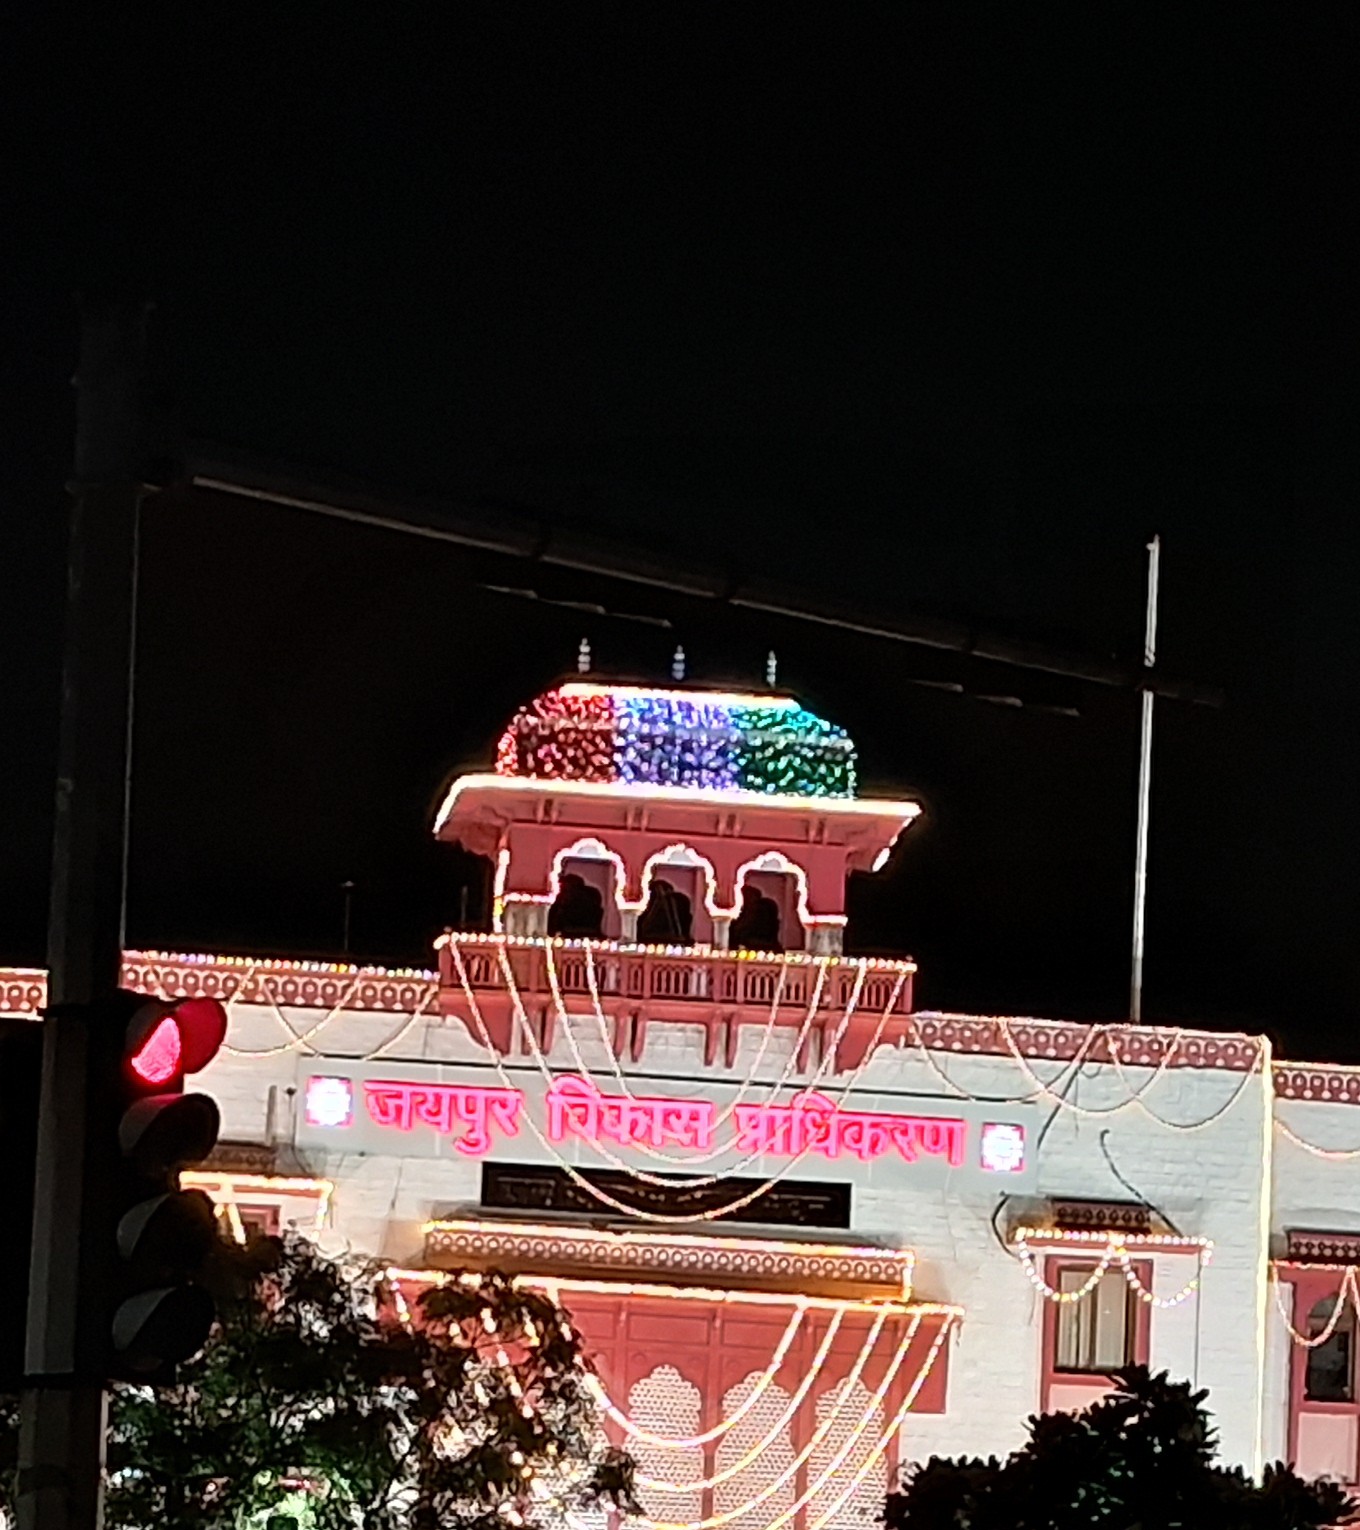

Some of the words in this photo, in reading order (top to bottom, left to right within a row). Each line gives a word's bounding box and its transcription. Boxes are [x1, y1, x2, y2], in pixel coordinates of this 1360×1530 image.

[363, 1080, 523, 1155] जयपुर
[547, 1073, 715, 1148] विकास
[734, 1090, 968, 1166] प्राधिकरण
